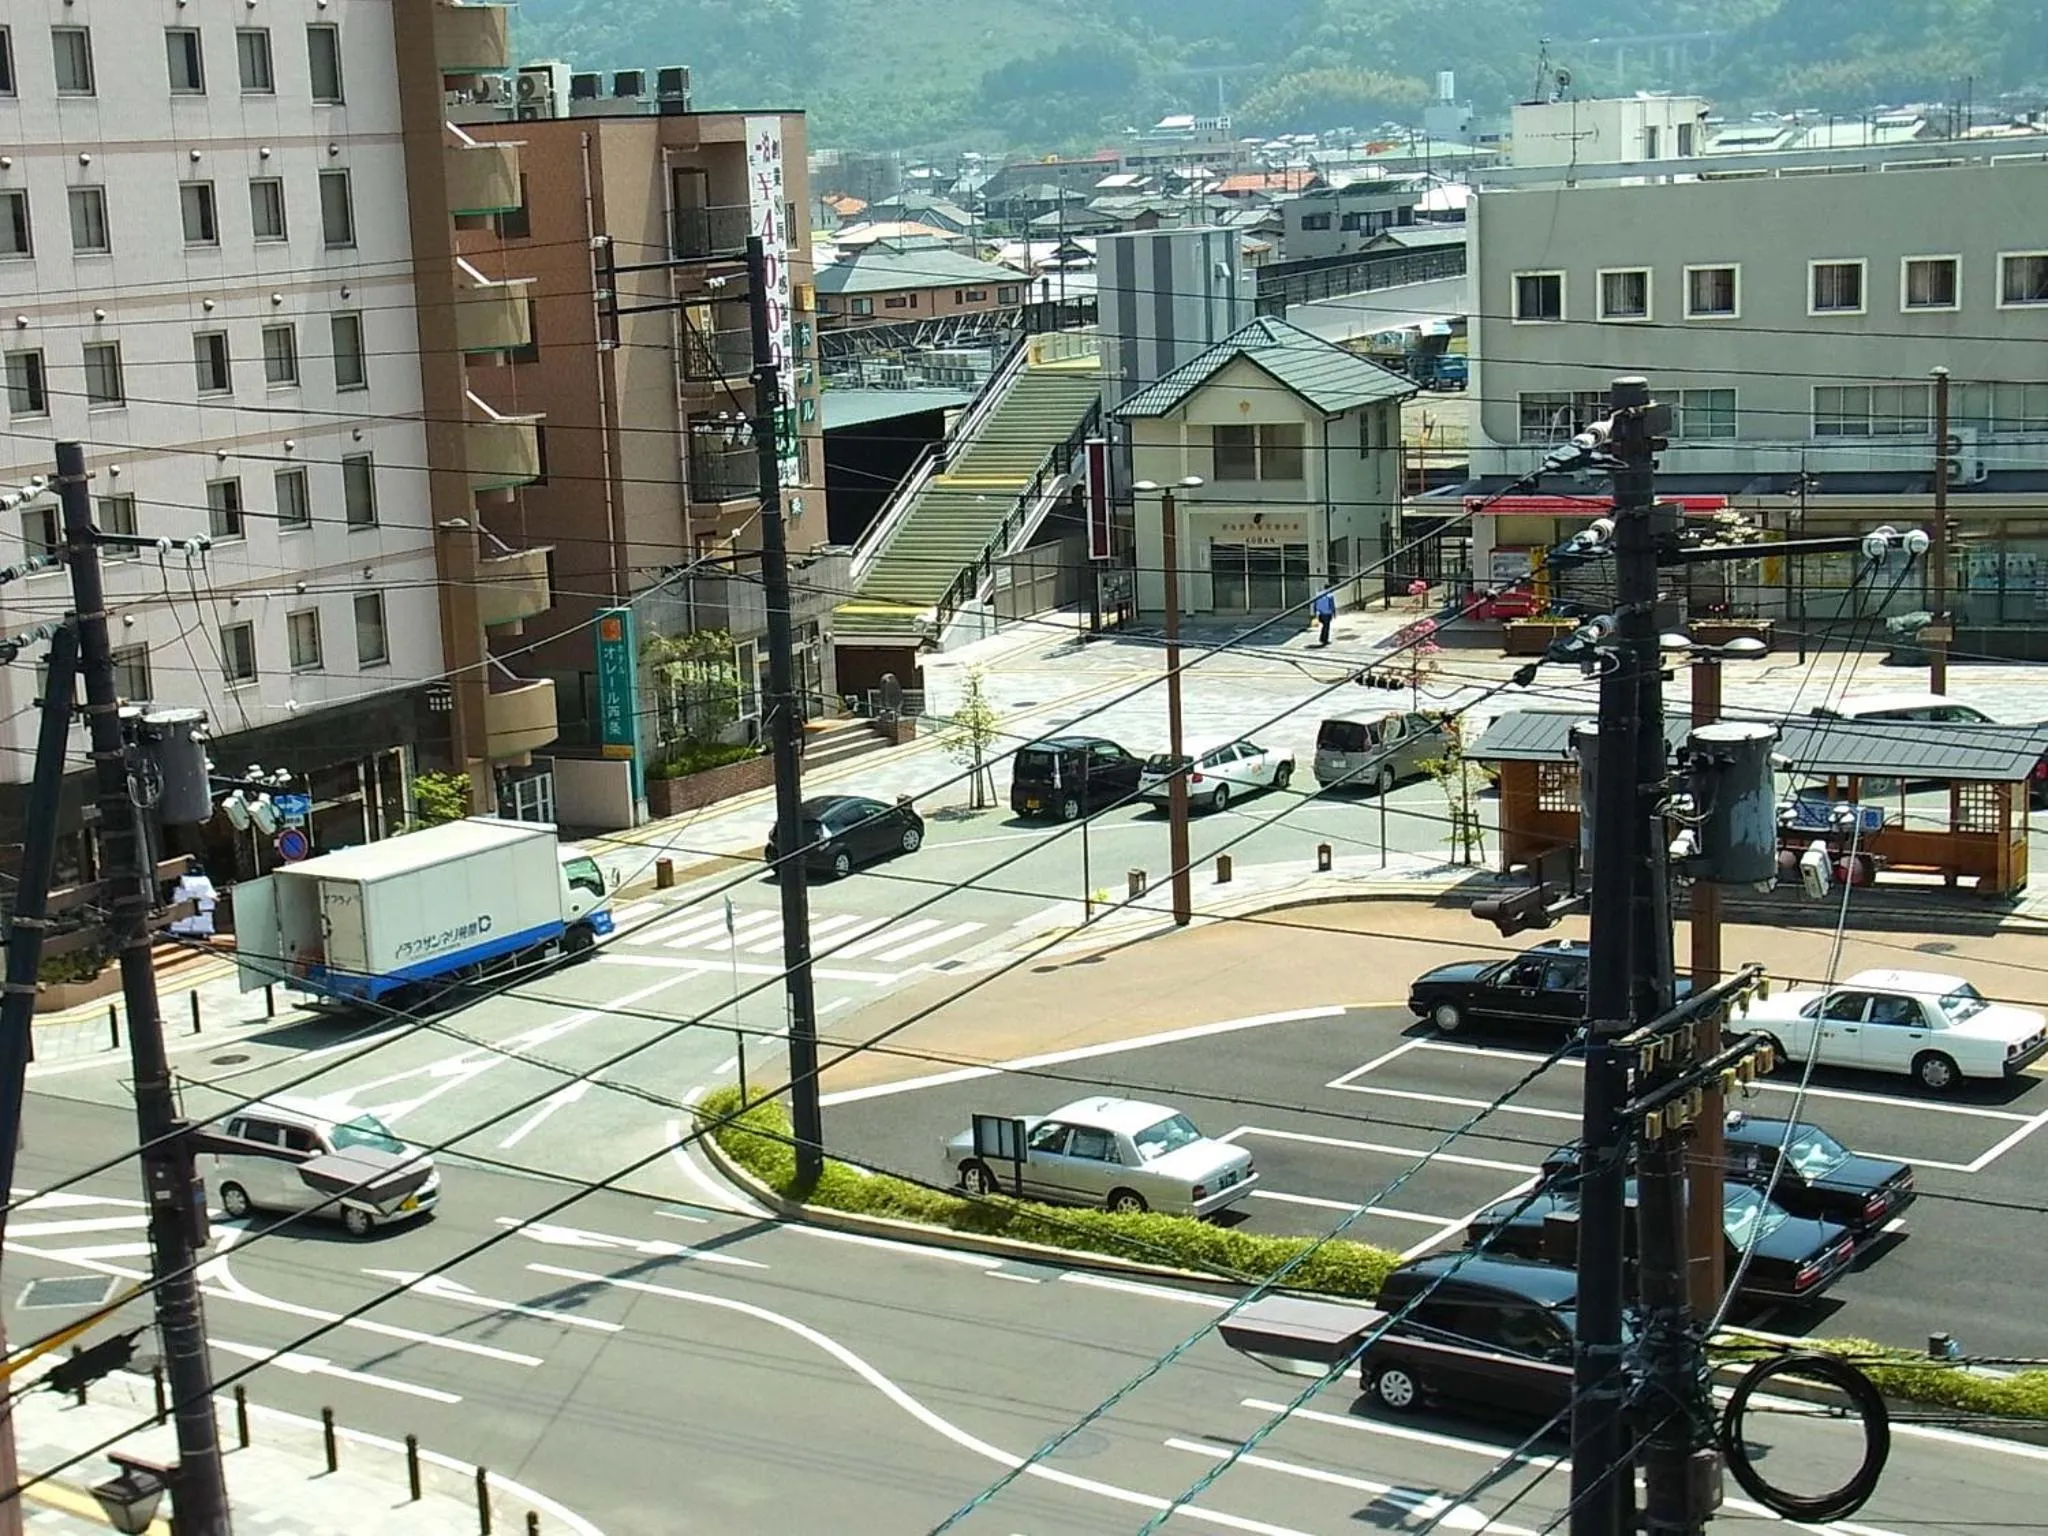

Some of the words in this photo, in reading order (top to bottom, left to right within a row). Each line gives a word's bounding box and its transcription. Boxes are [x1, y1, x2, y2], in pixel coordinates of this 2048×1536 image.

[799, 325, 815, 422] ホテル
[602, 646, 623, 736] オレール西条
